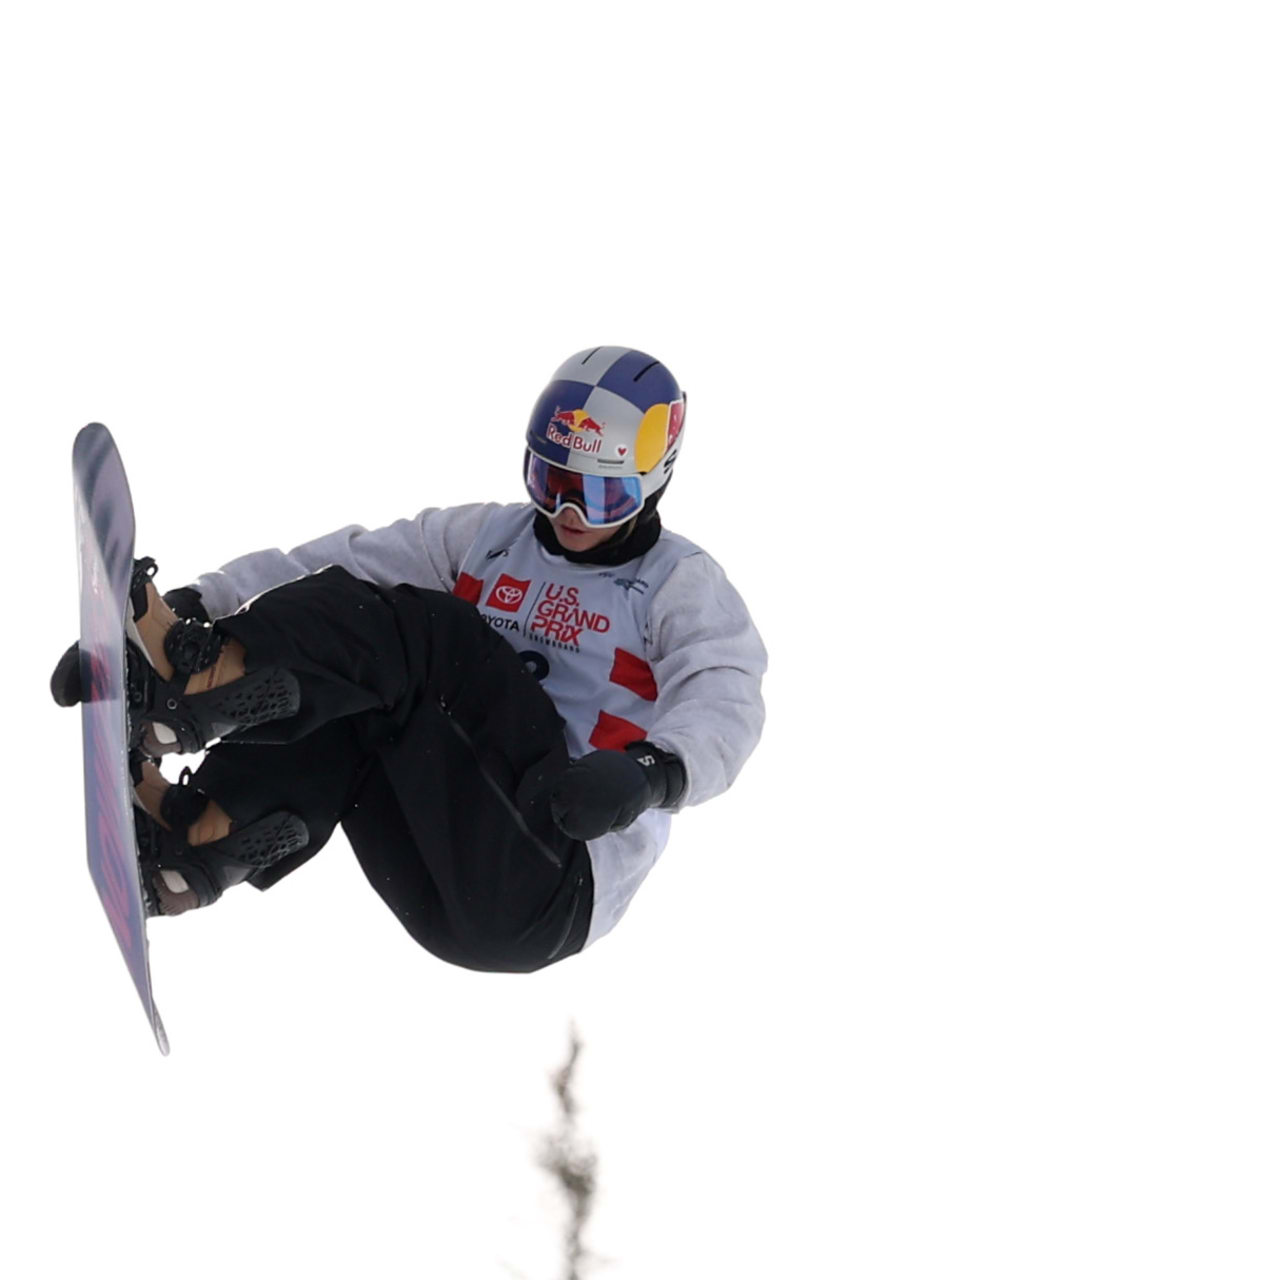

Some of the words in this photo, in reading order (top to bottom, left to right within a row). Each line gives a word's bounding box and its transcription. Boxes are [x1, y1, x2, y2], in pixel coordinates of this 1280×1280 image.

[546, 423, 571, 448] Red
[572, 435, 602, 453] Bull
[545, 583, 580, 606] U.S.
[481, 614, 520, 632] OYOTA
[530, 615, 584, 646] PRIX
[537, 599, 611, 633] GRAND
